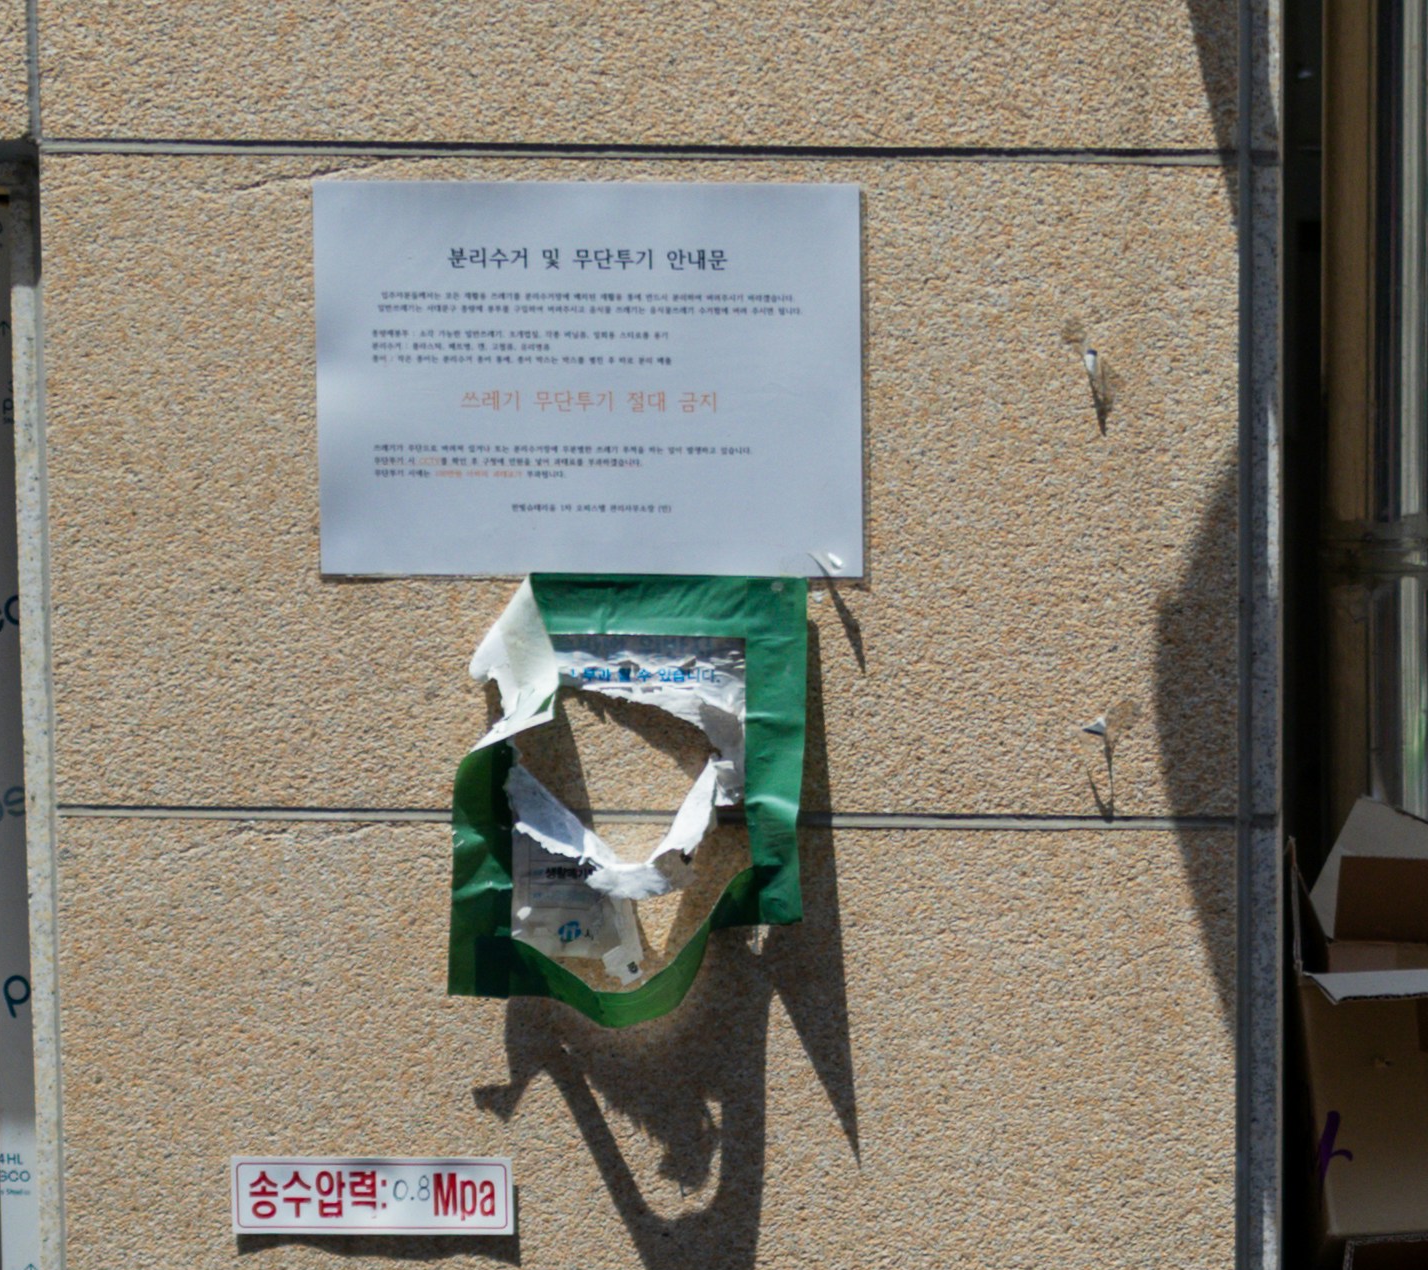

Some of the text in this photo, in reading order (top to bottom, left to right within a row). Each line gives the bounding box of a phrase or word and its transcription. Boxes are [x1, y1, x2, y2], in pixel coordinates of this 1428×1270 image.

[447, 247, 728, 270] 분리수거 및 무단투기 안내문
[460, 389, 718, 414] 쓰레기 무단투기 절대 금지
[637, 668, 651, 682] 수
[545, 866, 598, 881] 생활폐기
[249, 1170, 388, 1218] 송수압력:
[433, 1171, 496, 1221] Mpa
